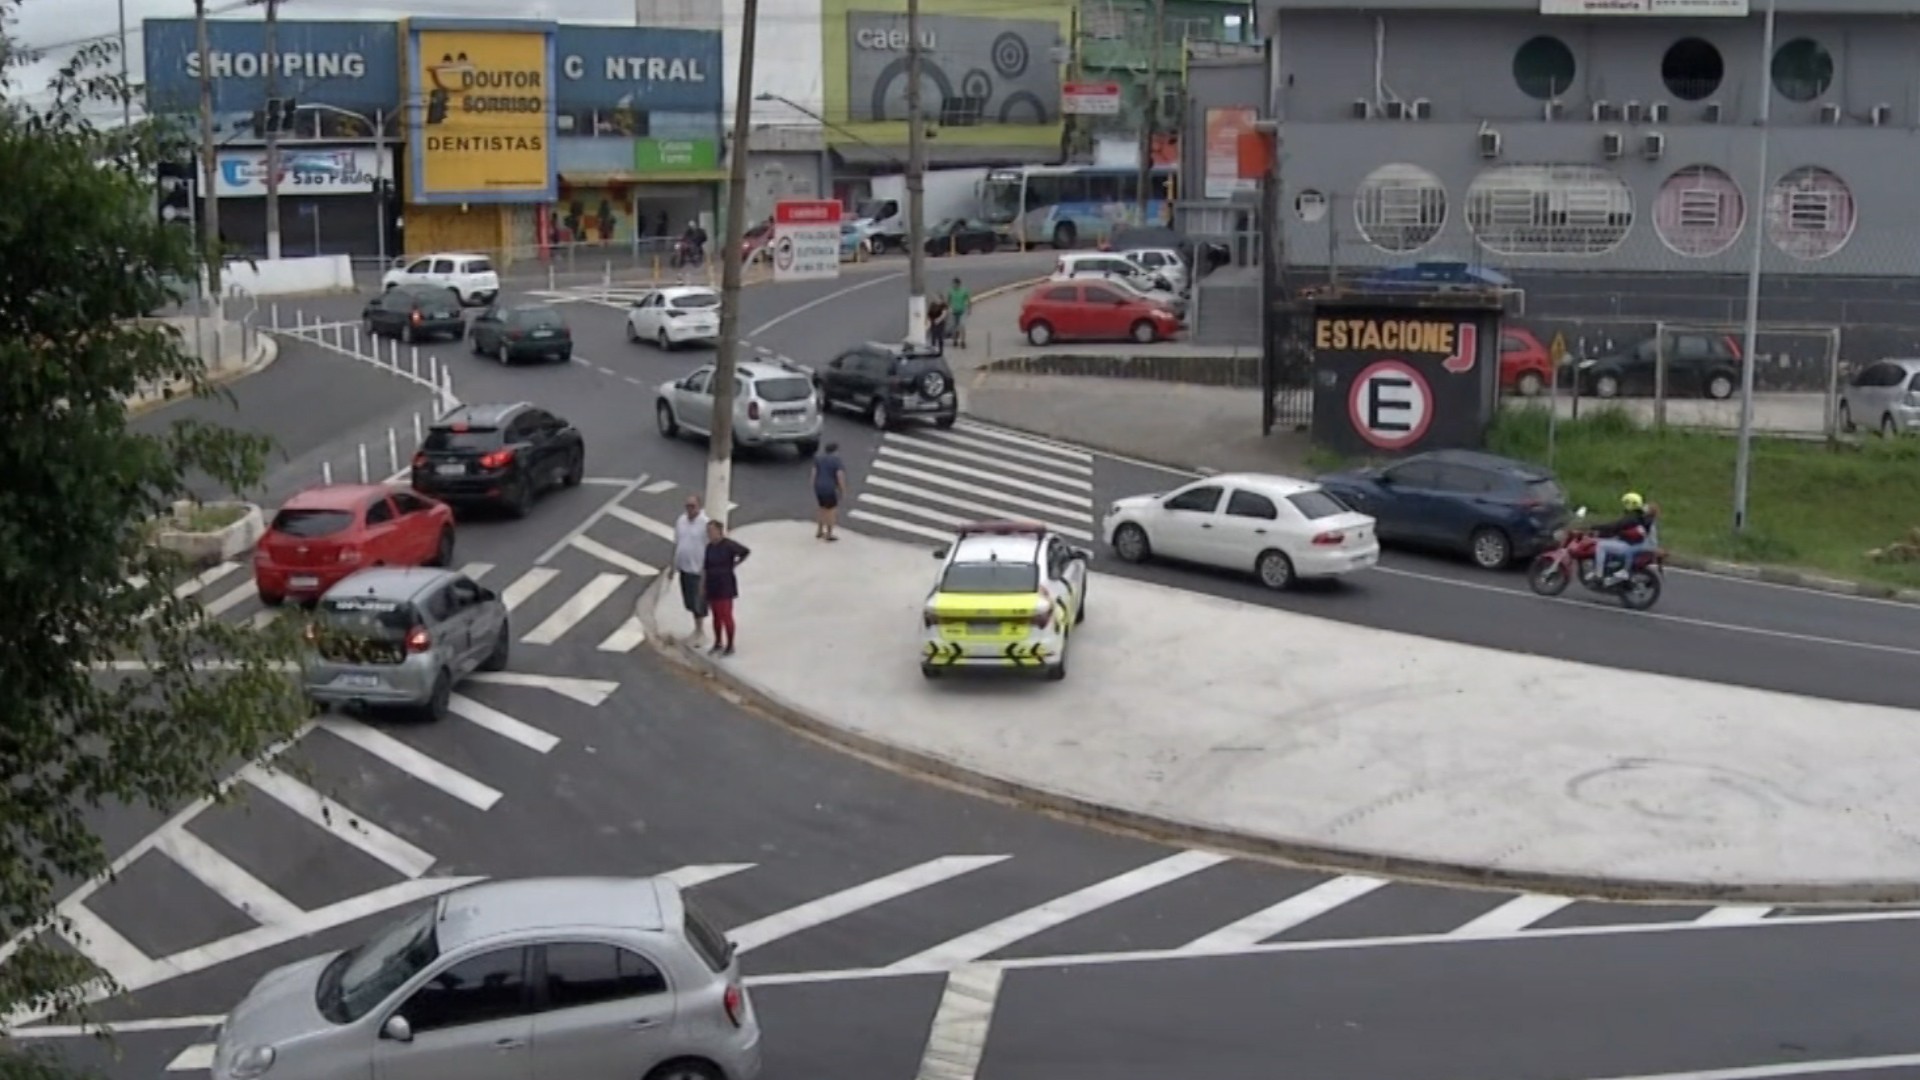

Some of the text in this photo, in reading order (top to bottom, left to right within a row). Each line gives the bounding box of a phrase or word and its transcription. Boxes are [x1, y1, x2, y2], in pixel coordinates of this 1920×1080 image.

[857, 27, 936, 49] caeu
[185, 52, 366, 78] SHOPPING
[462, 71, 542, 88] DOUTOR
[463, 95, 542, 114] SORRISO
[427, 136, 543, 151] DENTISTAS
[1316, 319, 1455, 353] ESTACIONE
[1369, 377, 1413, 431] E
